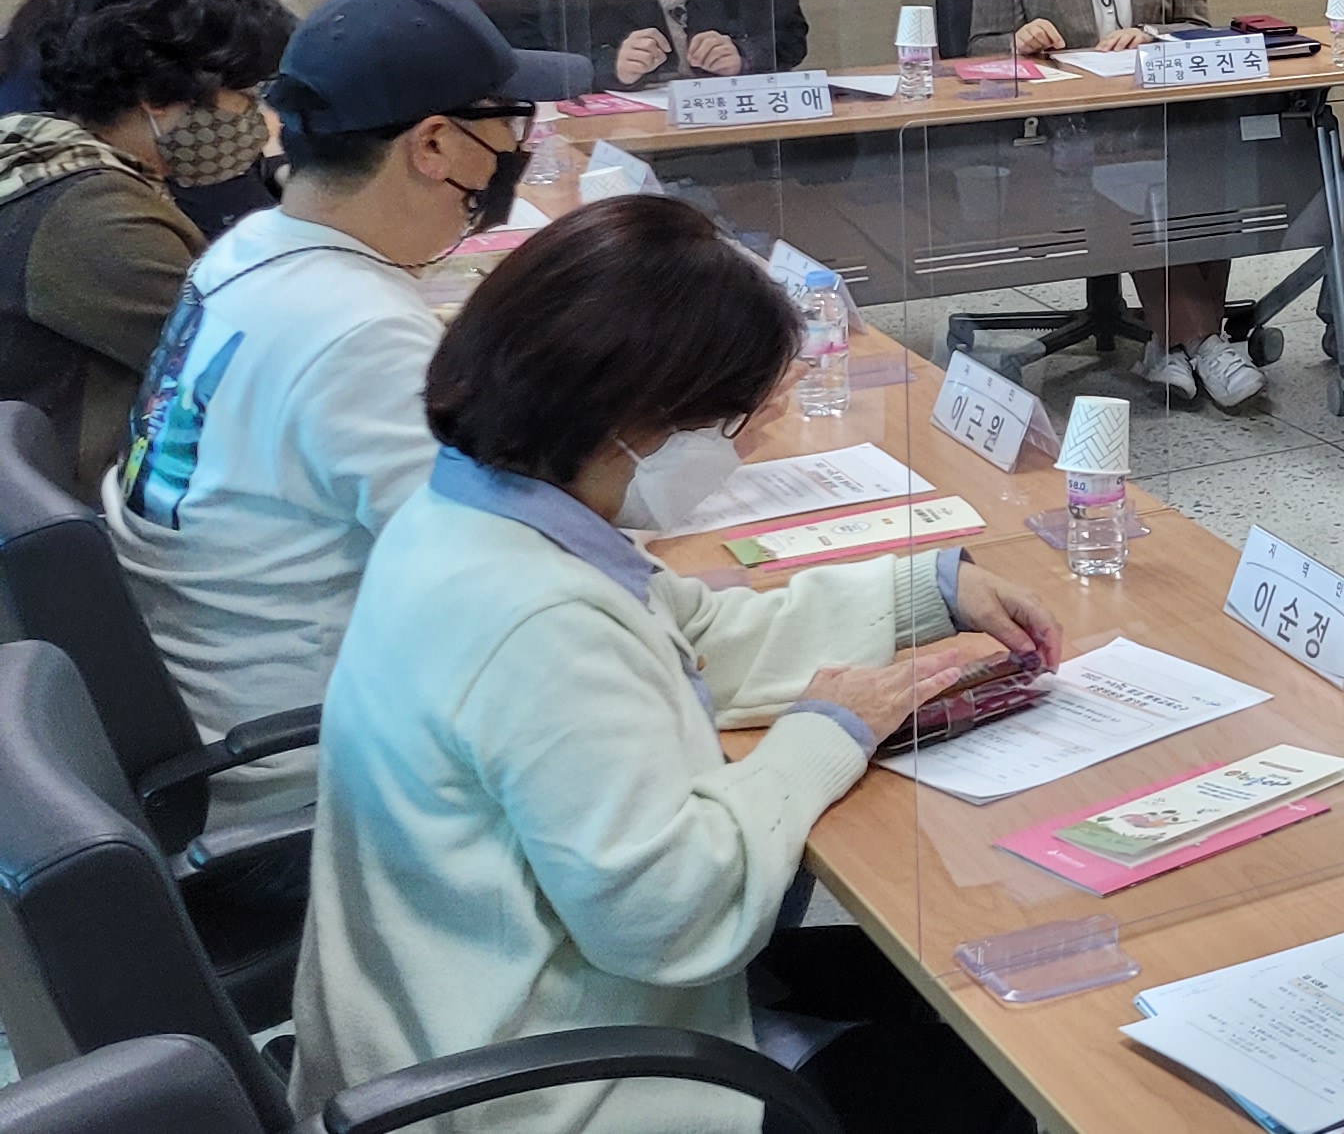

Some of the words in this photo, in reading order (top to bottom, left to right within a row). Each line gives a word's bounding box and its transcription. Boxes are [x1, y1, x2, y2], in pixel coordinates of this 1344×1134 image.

[1188, 51, 1263, 77] 옥진숙
[1268, 542, 1344, 599] 지역민
[1254, 581, 1331, 659] 이순정
